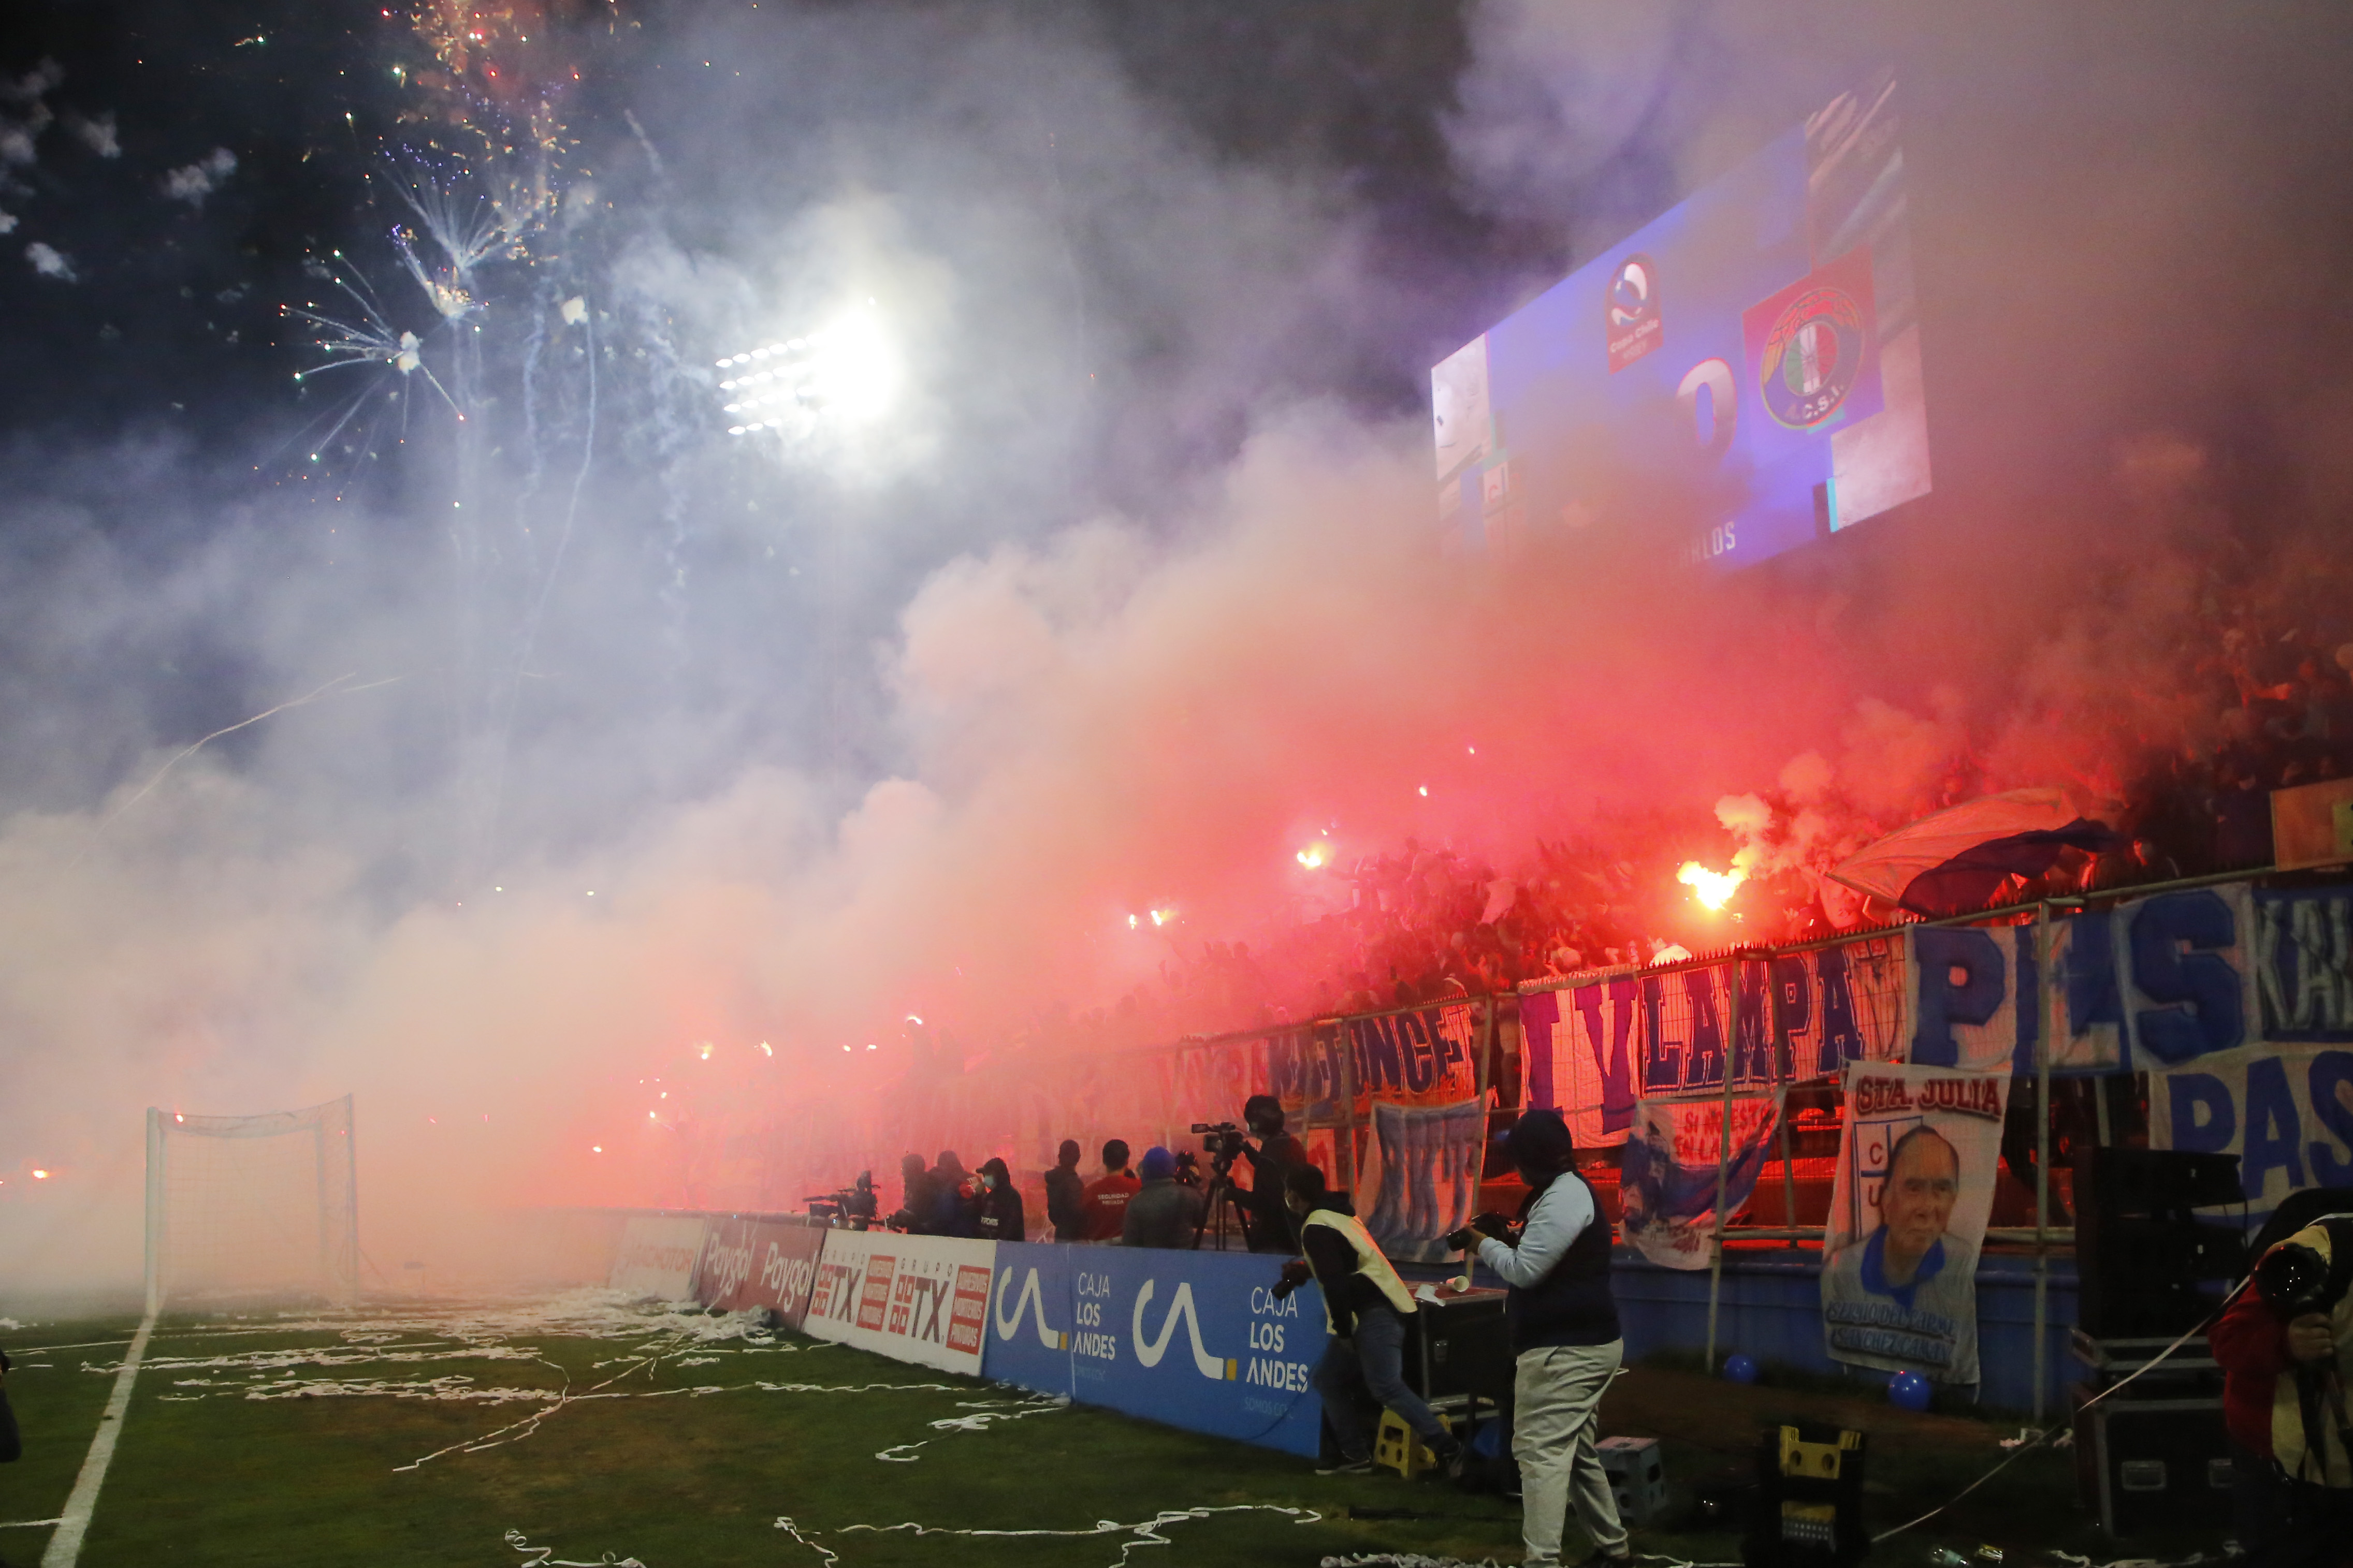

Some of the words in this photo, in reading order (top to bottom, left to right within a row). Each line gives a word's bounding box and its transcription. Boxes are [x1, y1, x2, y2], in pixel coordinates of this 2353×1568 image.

[1642, 945, 1864, 1092] LAMPA
[1856, 1075, 1913, 1115] STA.
[1918, 1077, 2002, 1119] JULIA
[1869, 1142, 1883, 1164] C
[704, 1232, 756, 1296] Paygol
[760, 1241, 818, 1313] Paygol
[900, 1257, 953, 1277] GRUPO
[1078, 1272, 1110, 1297] CAJA
[1076, 1301, 1101, 1327] LOS
[1251, 1286, 1298, 1318] CAJA
[1073, 1331, 1116, 1360] ANDES
[1250, 1321, 1285, 1353] LOS
[1246, 1356, 1309, 1394] ANDES
